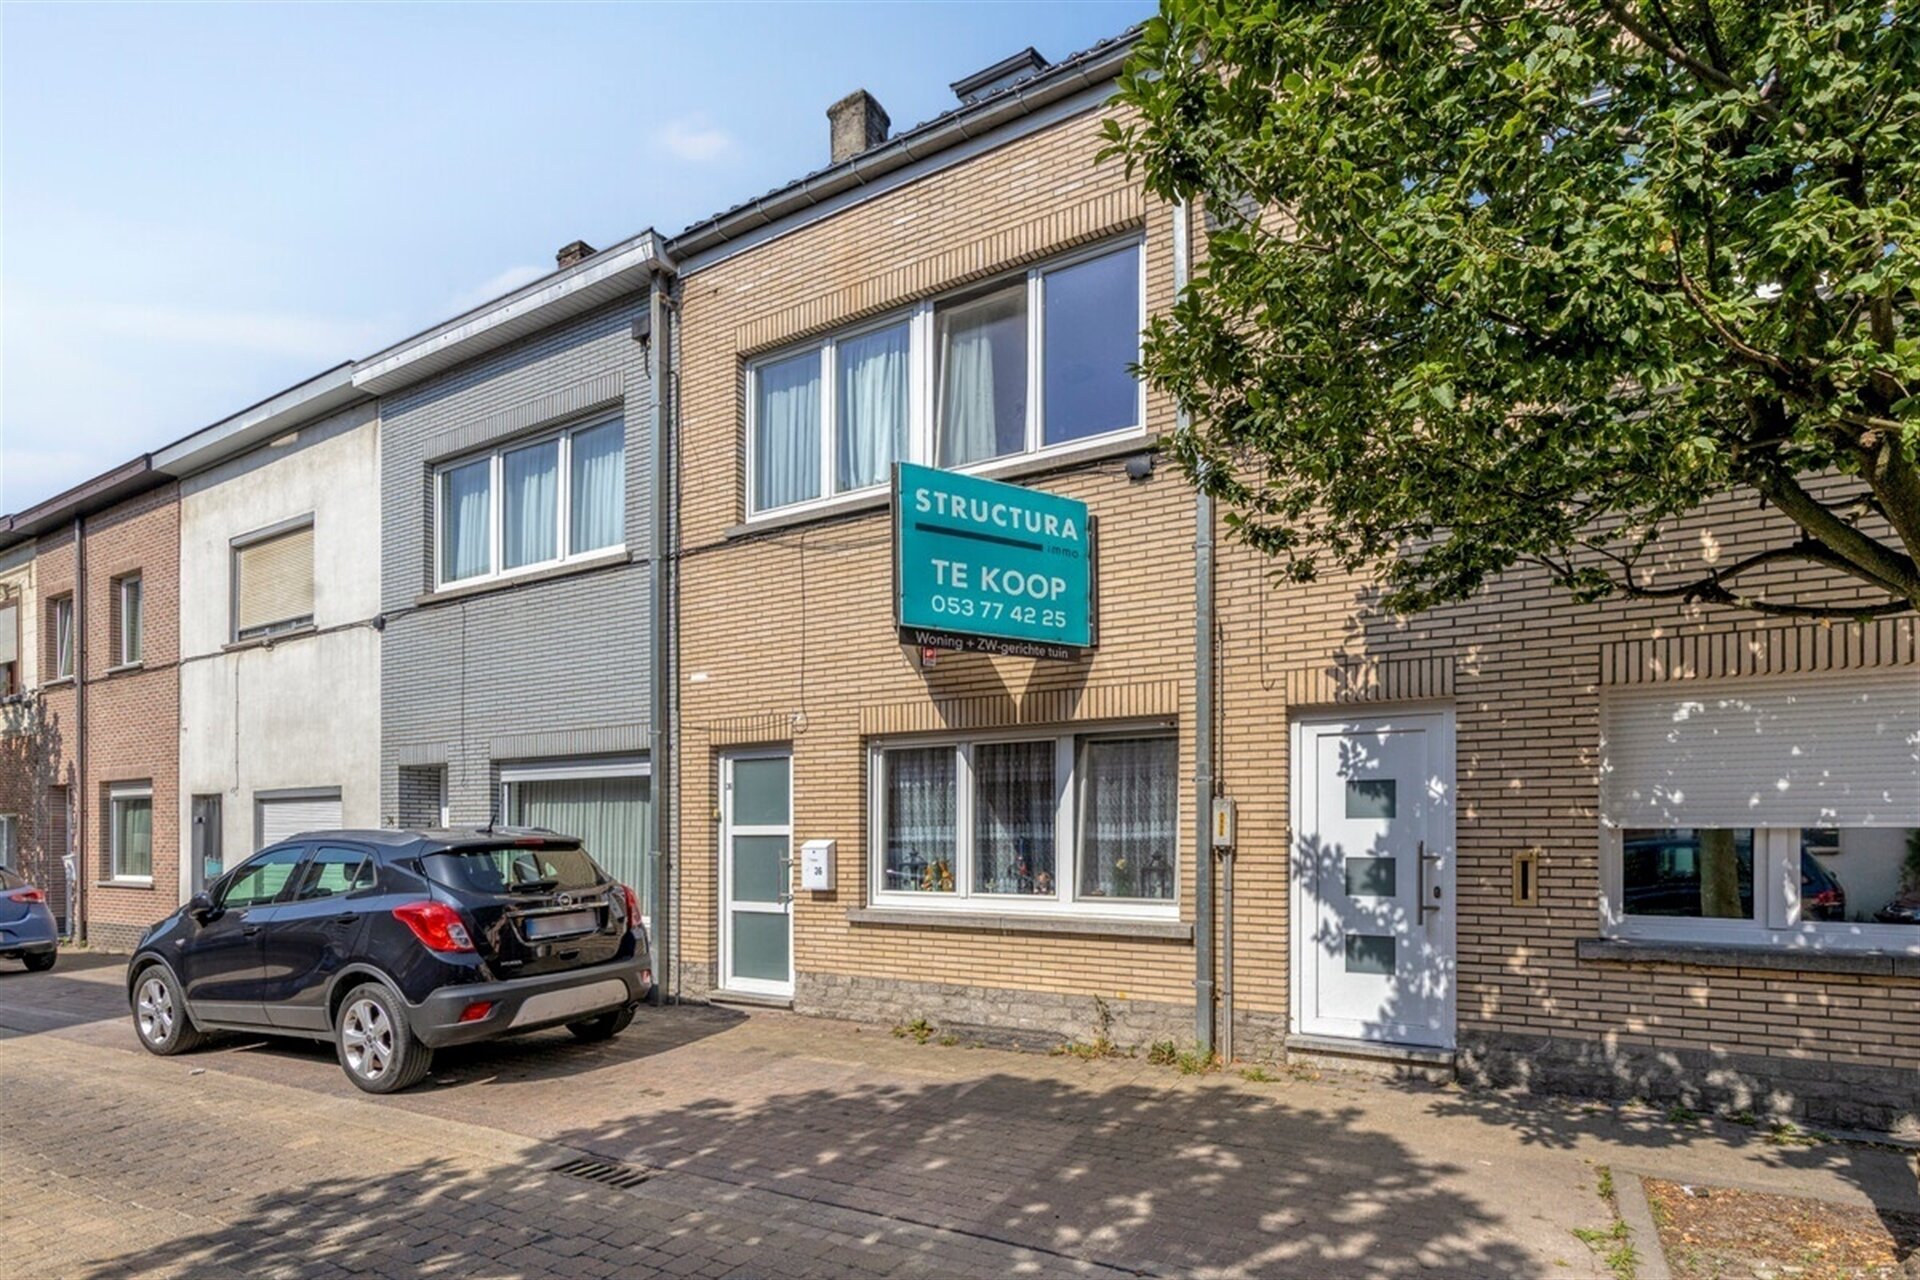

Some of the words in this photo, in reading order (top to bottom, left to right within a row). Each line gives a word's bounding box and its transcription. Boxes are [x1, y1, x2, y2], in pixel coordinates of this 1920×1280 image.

[916, 488, 1079, 540] STRUCTURA
[1047, 545, 1079, 559] immo
[931, 559, 968, 588] TE
[981, 566, 1067, 601] KOOP
[931, 595, 974, 616] 053
[980, 601, 1004, 620] 77
[1010, 605, 1036, 622] 42
[1042, 609, 1066, 628] 25
[915, 631, 963, 651] Woning
[967, 640, 974, 648] +
[977, 638, 1046, 657] ZW-gerichte
[1048, 647, 1069, 659] tuin
